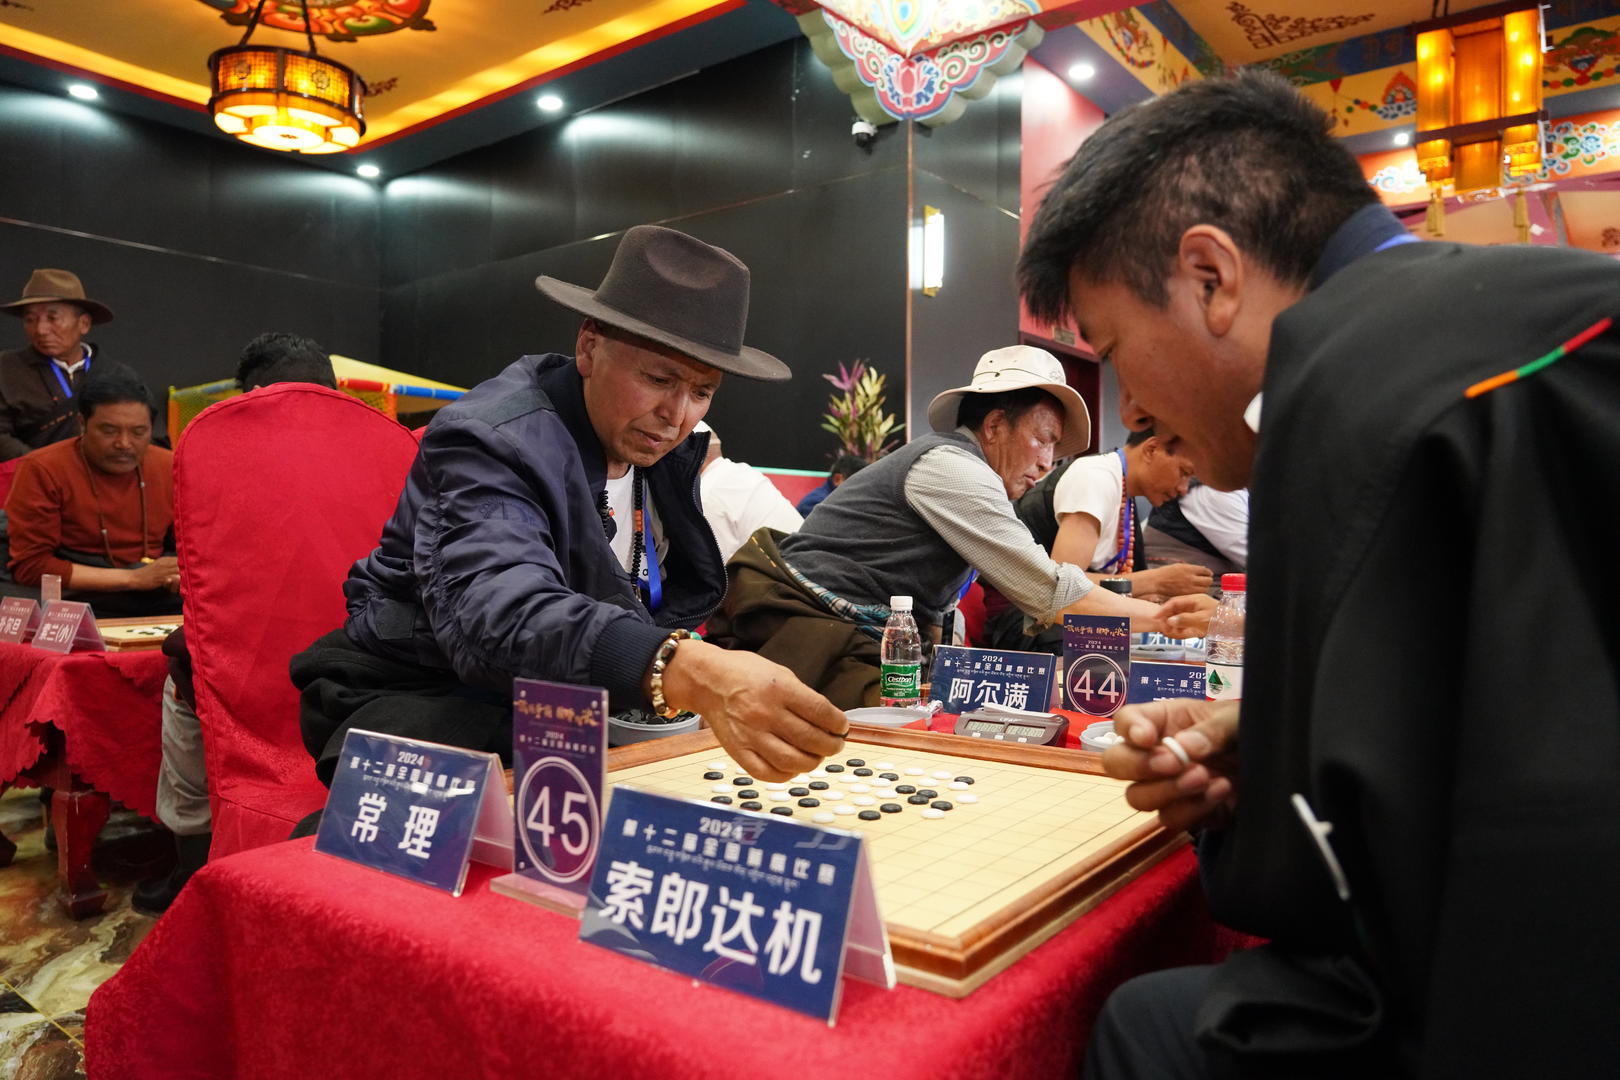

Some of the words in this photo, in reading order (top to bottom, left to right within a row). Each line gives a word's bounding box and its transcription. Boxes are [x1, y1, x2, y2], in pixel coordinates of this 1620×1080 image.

[982, 655, 1003, 663] 2024
[1073, 669, 1119, 703] 44
[1189, 671, 1206, 680] 202
[948, 678, 1030, 710] 阿尔满
[397, 751, 425, 766] 2024
[351, 792, 440, 860] 常理
[527, 786, 589, 855] 45
[699, 817, 743, 841] 2024
[599, 860, 822, 985] 索郎达机
